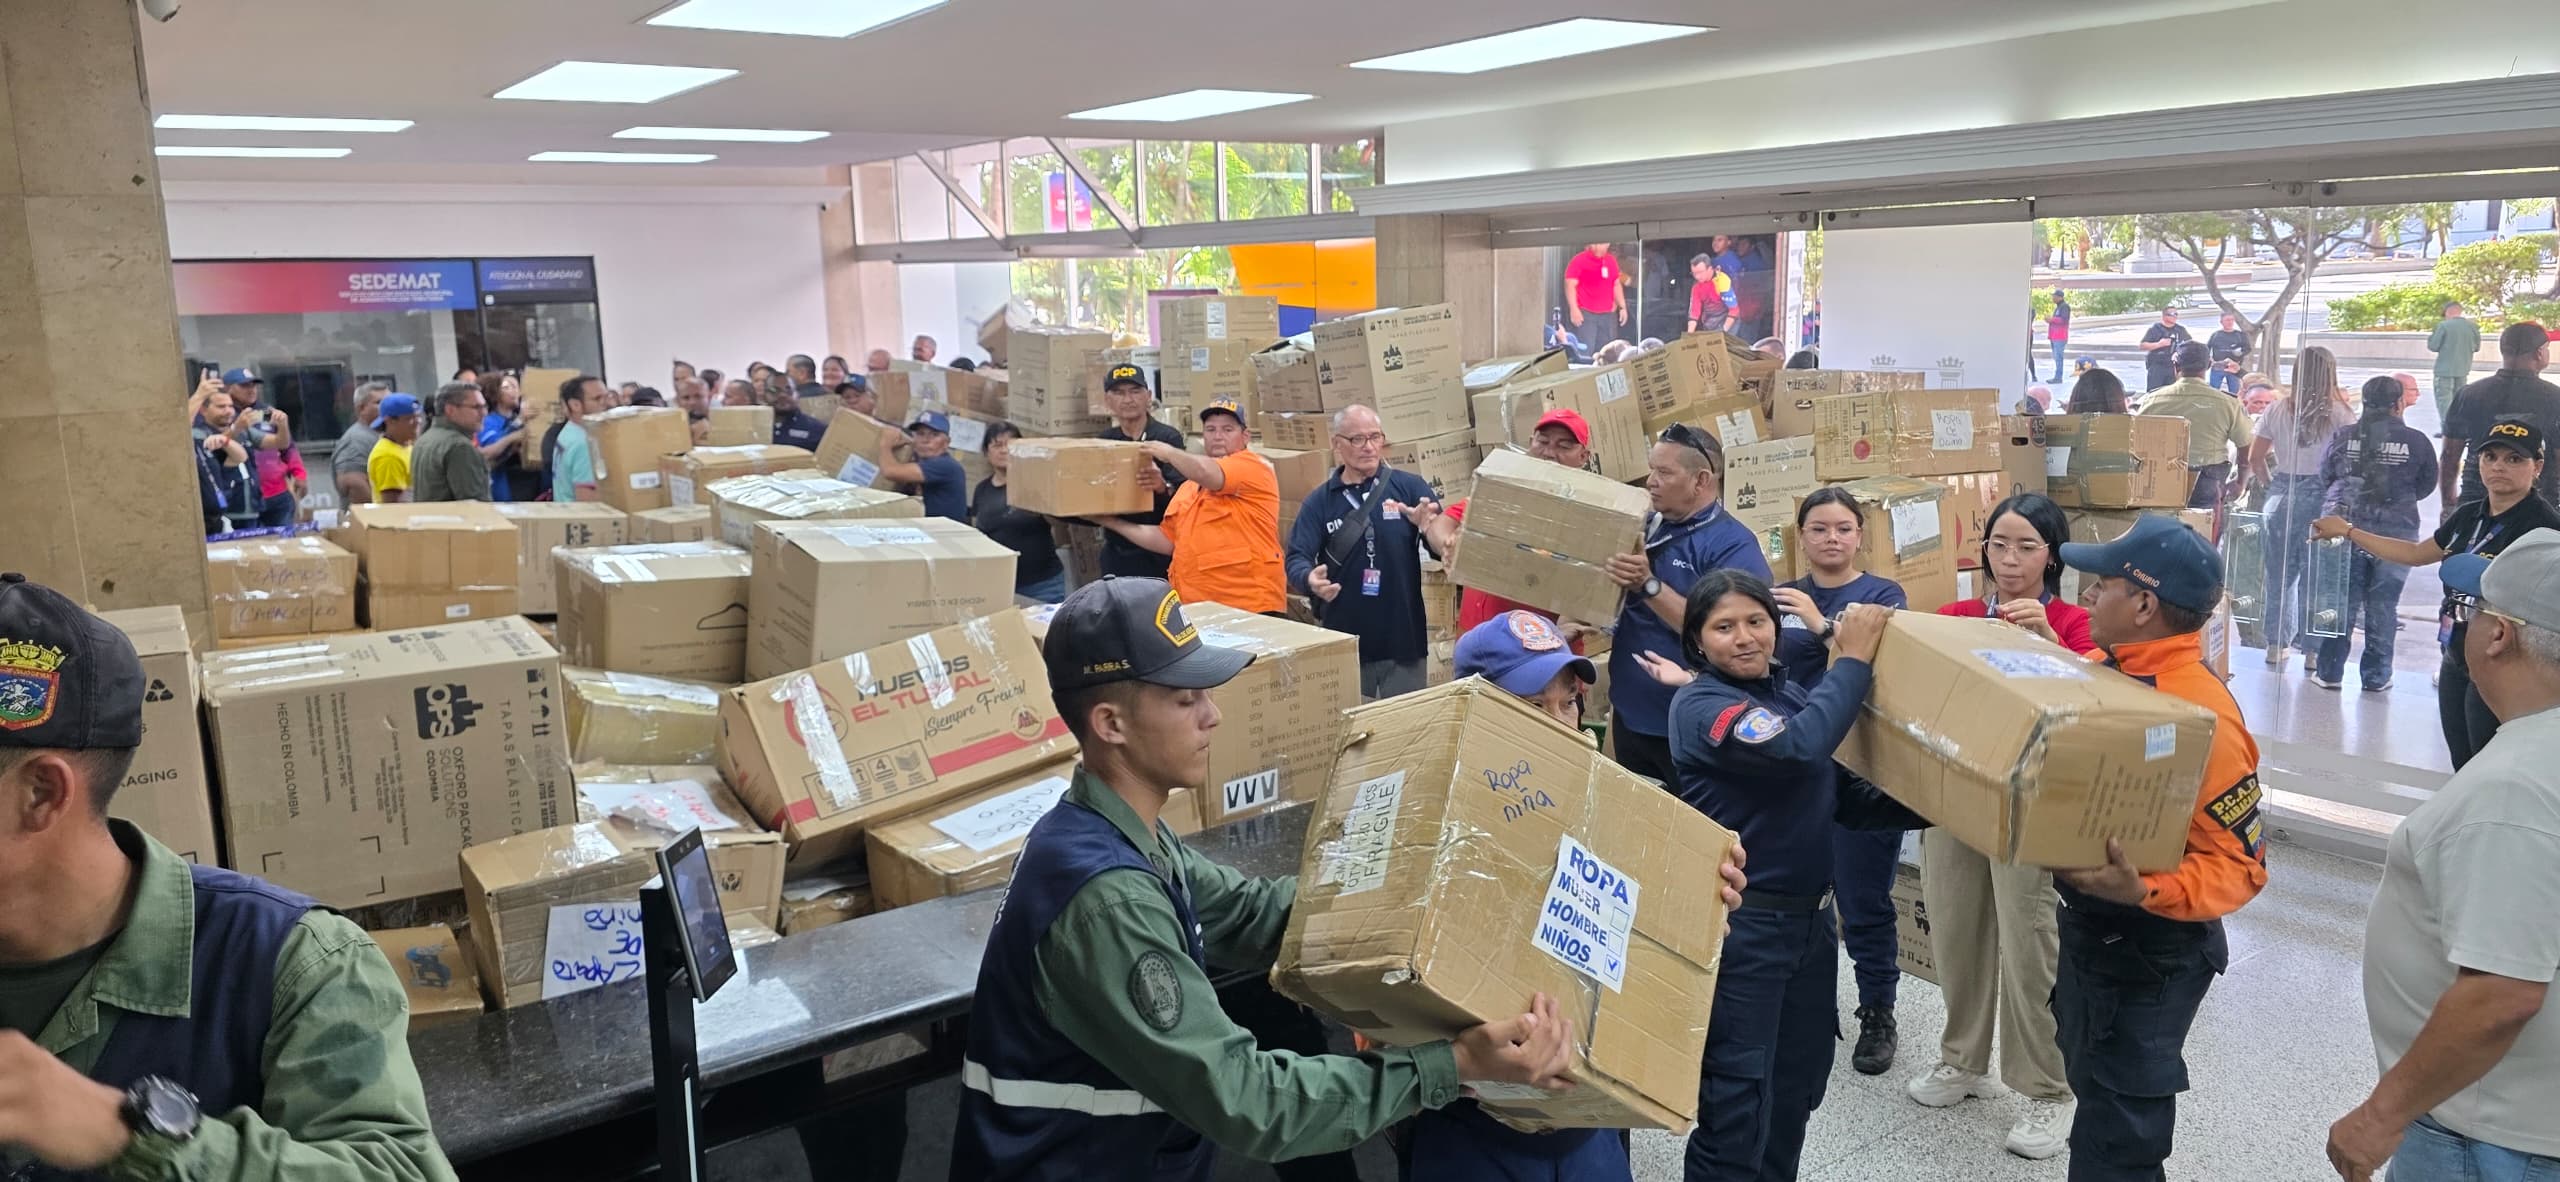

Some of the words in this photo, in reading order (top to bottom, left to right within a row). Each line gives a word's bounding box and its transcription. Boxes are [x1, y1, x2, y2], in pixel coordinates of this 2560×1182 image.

[348, 273, 441, 289] SEDEMAT
[1113, 367, 1137, 379] PCP
[2489, 424, 2529, 437] PCP
[1737, 494, 1756, 505] OPS
[426, 685, 455, 740] OPS
[851, 701, 889, 723] EL
[890, 671, 991, 709] TUAL
[277, 702, 291, 742] HECHO
[499, 700, 515, 752] TAPAS
[282, 745, 293, 759] EN
[452, 746, 468, 799] OXFORD
[110, 769, 177, 790] AGING
[283, 761, 300, 819] COLOMBIA
[427, 750, 439, 802] COLOMBIA
[440, 748, 457, 819] SOLUTIONS
[1364, 783, 1378, 811] PCS
[1363, 784, 1396, 877] FRAGILE
[1557, 872, 1601, 915] MUJER
[1569, 846, 1630, 906] ROPA
[1541, 923, 1592, 963] NIÑOS
[1547, 896, 1608, 947] HOMBRE
